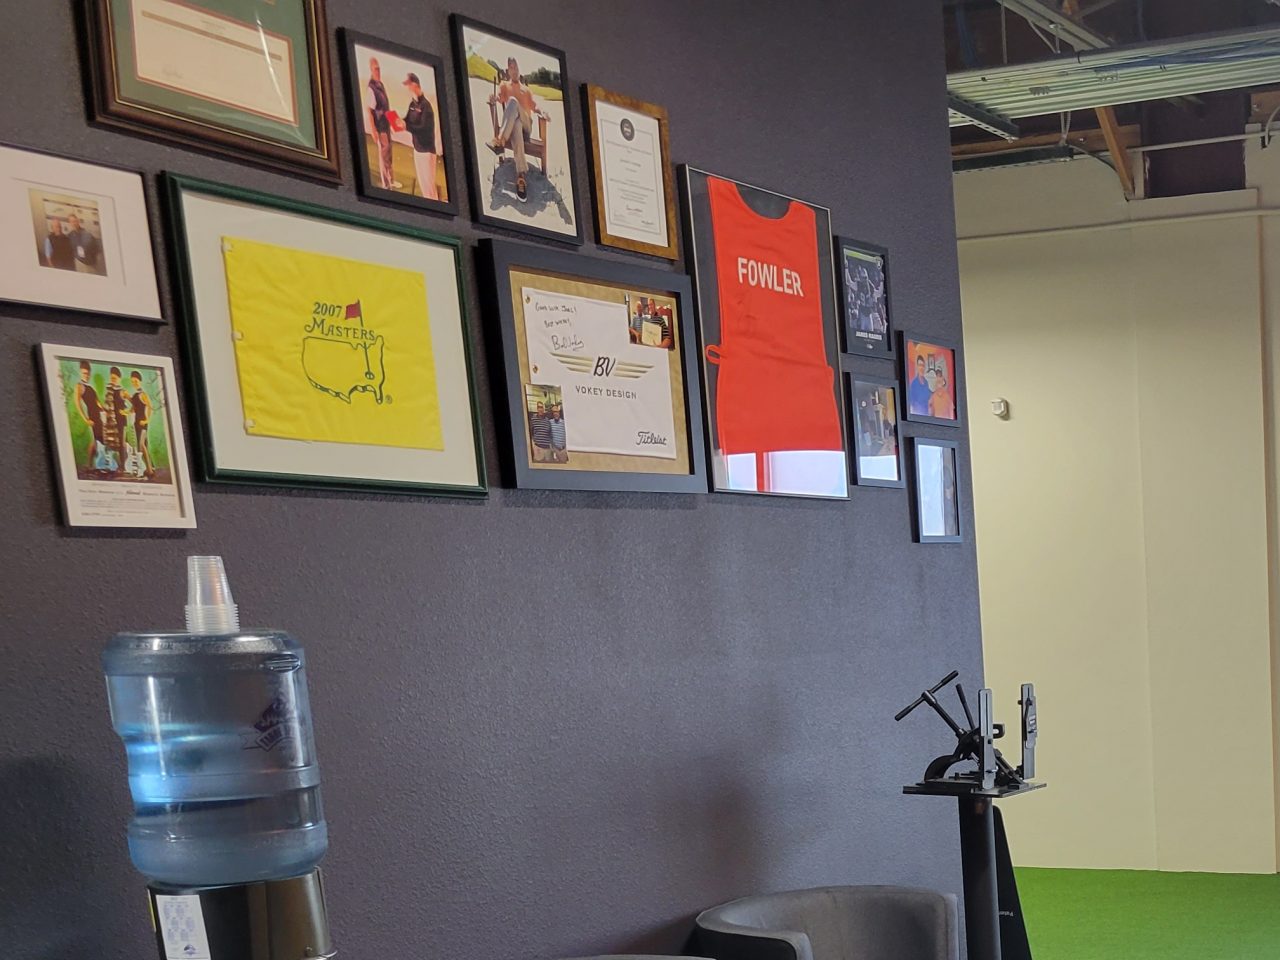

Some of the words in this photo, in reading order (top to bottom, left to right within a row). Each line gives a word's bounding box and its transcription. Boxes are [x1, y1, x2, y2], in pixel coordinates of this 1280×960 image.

[737, 256, 804, 297] FOWLER
[313, 302, 342, 317] 2007
[593, 356, 616, 377] BV
[575, 385, 603, 397] VOKEY
[606, 388, 637, 400] DESIGN
